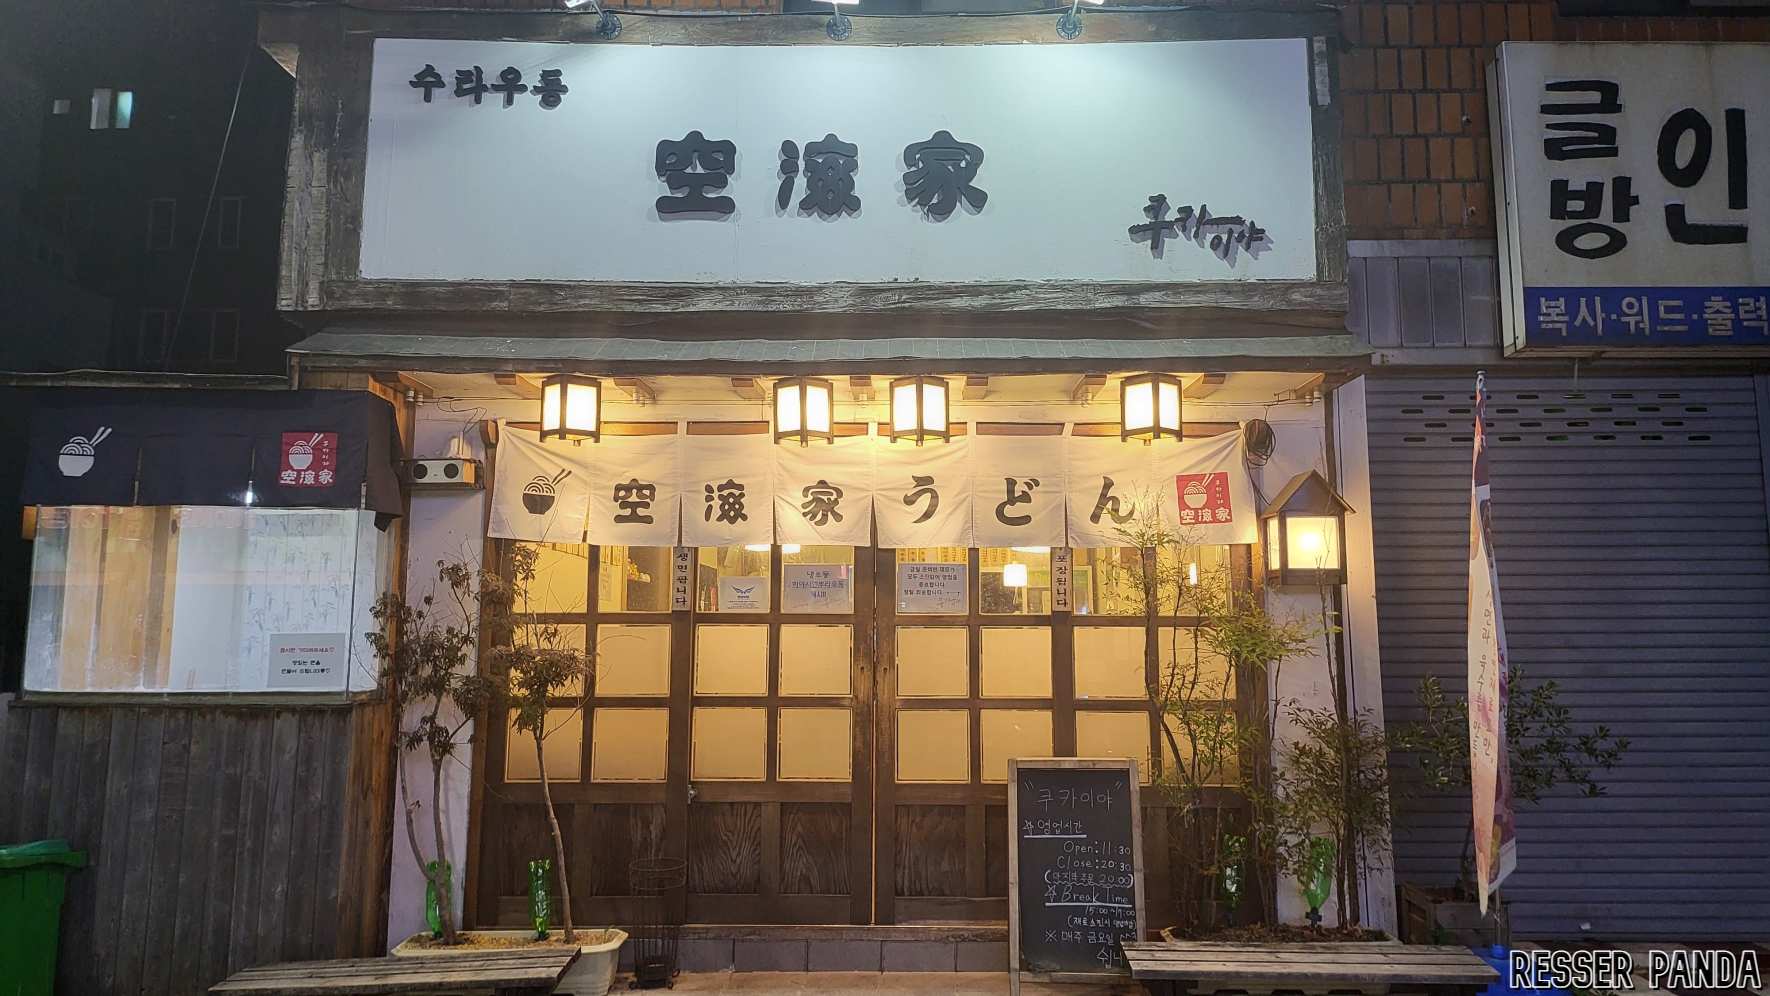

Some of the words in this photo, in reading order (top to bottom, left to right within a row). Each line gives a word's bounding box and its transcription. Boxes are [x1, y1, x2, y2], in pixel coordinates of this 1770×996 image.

[409, 64, 569, 107] 수타우동
[1037, 819, 1083, 835] 영업시간
[1061, 884, 1099, 903] Break
[1102, 886, 1128, 903] Time
[1061, 931, 1082, 943] 매주
[1087, 931, 1114, 946] 금요일
[1096, 947, 1123, 968] 쉽니
